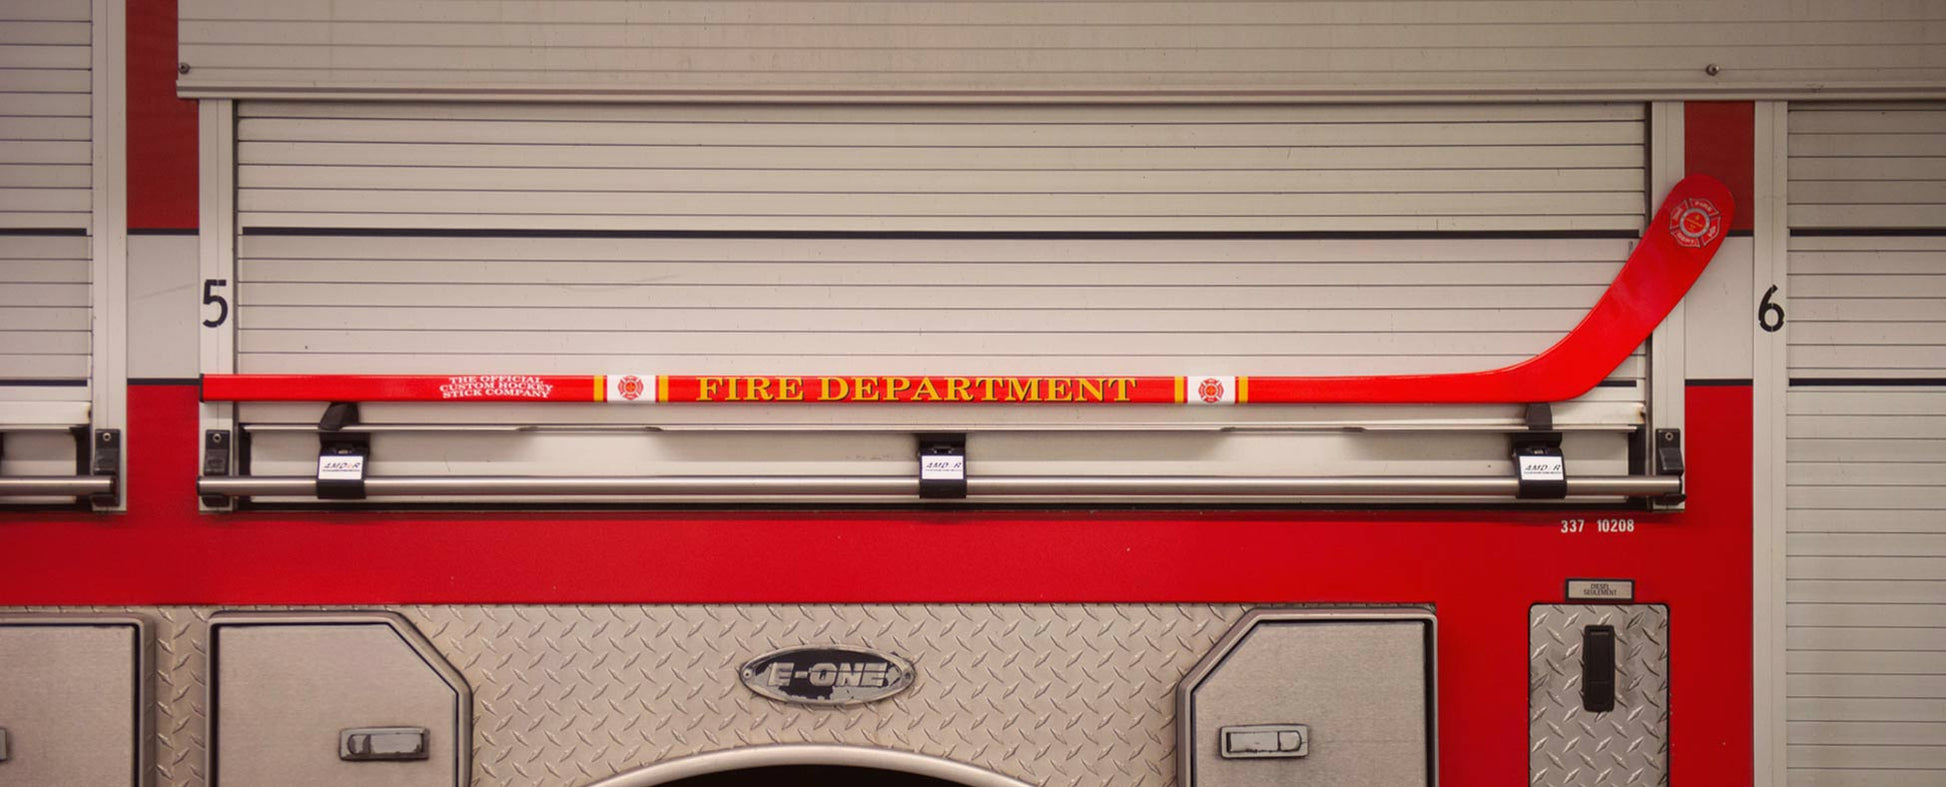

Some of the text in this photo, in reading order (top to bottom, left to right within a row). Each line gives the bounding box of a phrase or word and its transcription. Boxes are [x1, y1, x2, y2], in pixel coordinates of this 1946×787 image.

[202, 279, 228, 328] 5
[1758, 284, 1785, 332] 6
[439, 382, 554, 392] CUSTOM HOCKEY
[448, 375, 543, 384] THE OFFICIAL
[696, 376, 1136, 402] FIRE DEPARTMENT
[442, 389, 549, 399] STICK COMPANY
[1560, 519, 1635, 533] 337 10208
[767, 662, 888, 687] E-ONE
